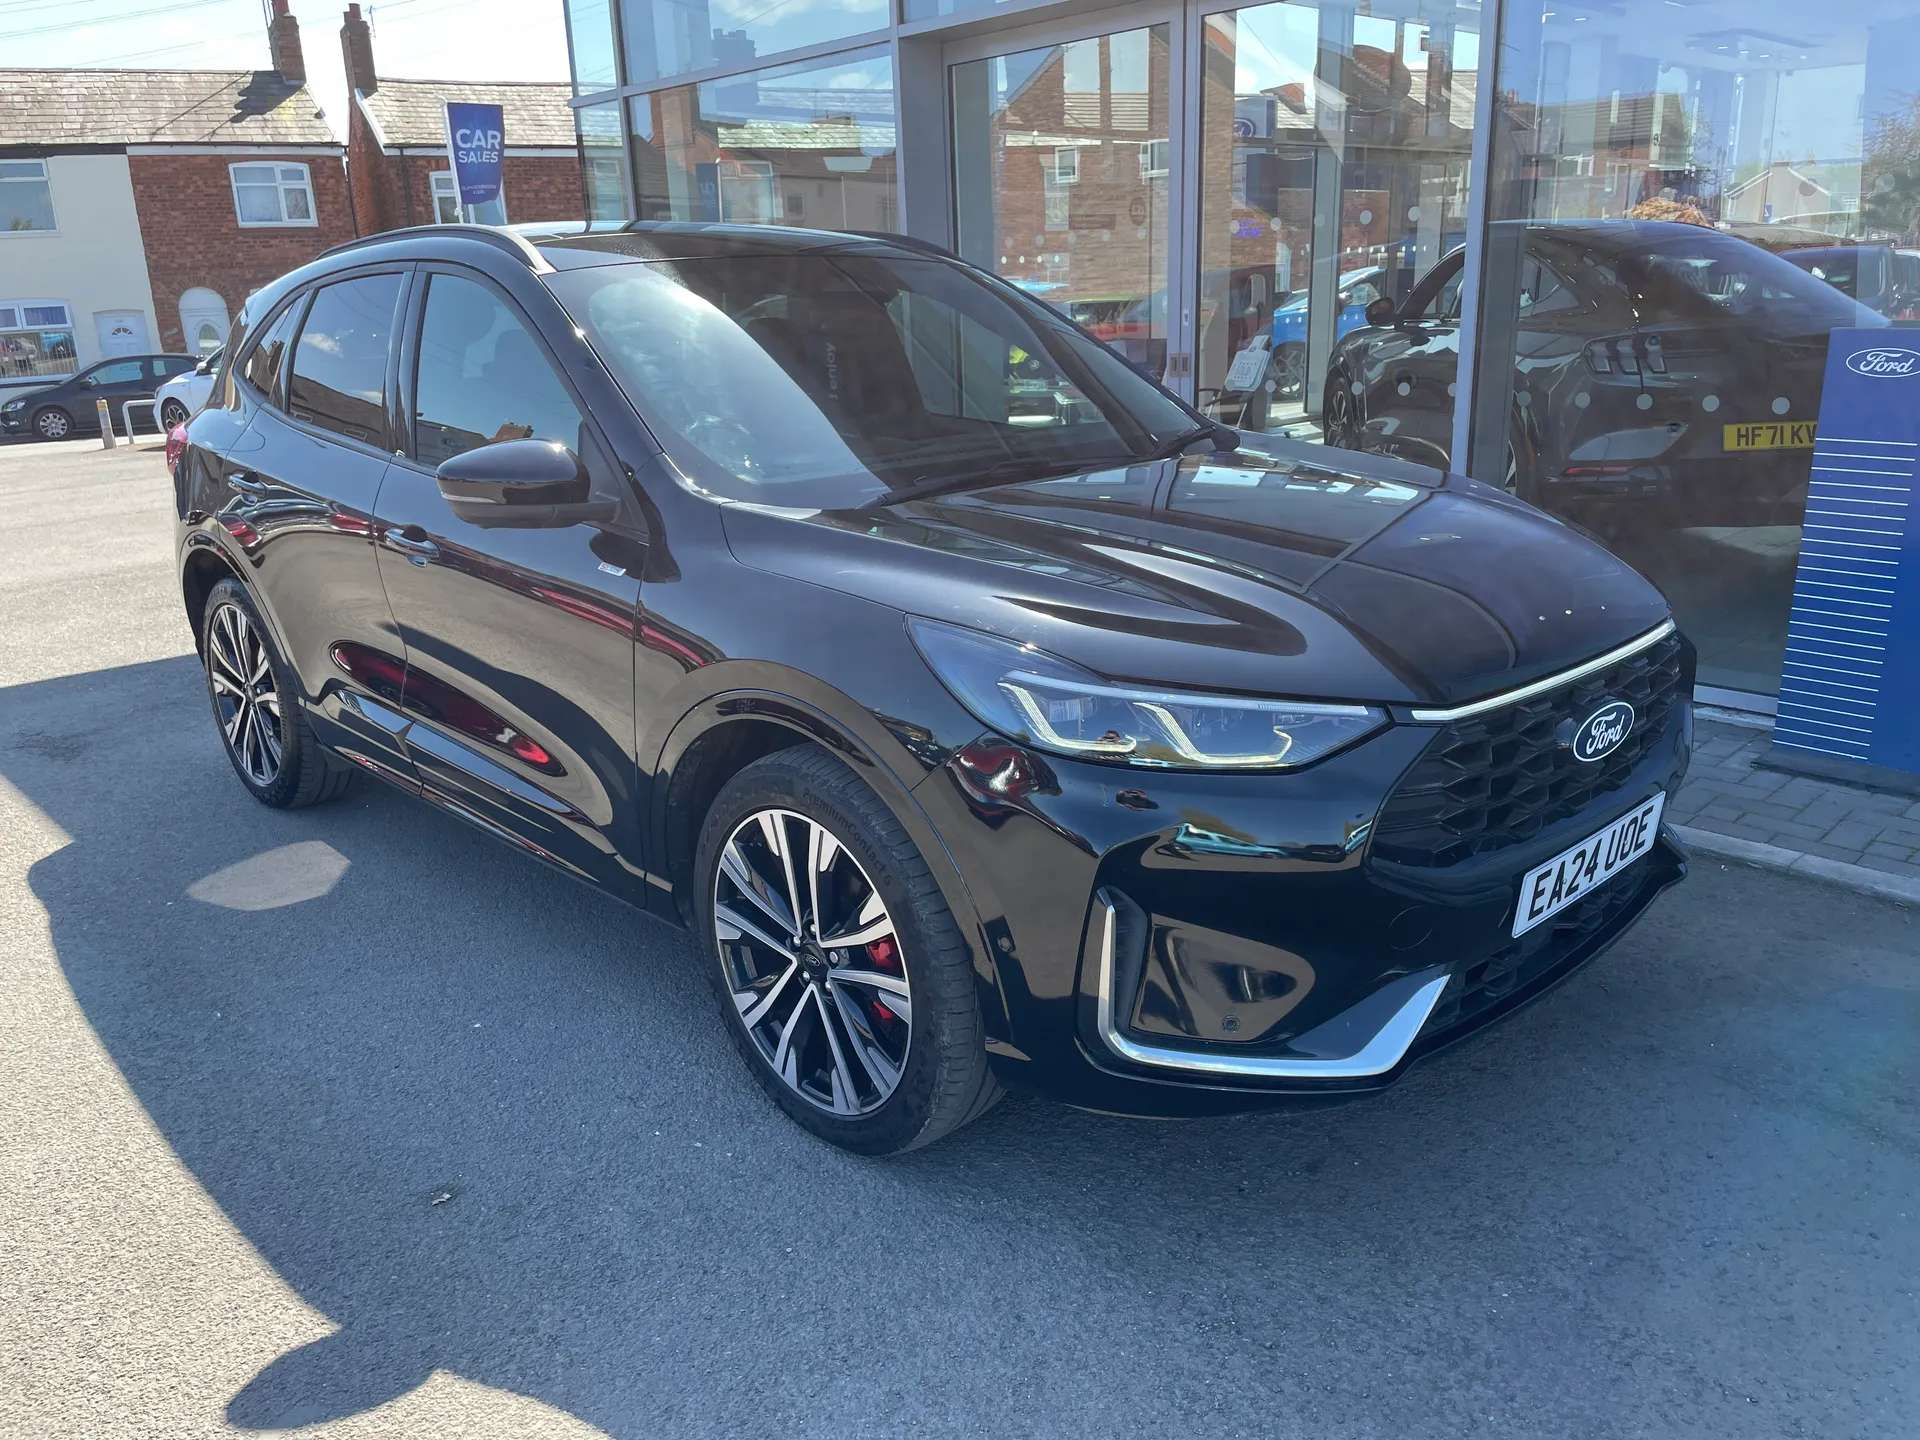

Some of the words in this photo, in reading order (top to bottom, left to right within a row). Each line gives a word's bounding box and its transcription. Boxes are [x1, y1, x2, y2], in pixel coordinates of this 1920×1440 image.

[456, 128, 501, 149] CAR
[458, 151, 498, 164] SALES
[1859, 351, 1916, 373] Ford
[1736, 425, 1784, 447] HF71
[1585, 711, 1625, 755] Ford
[1527, 838, 1602, 922] EA24
[1604, 804, 1655, 873] UOE
